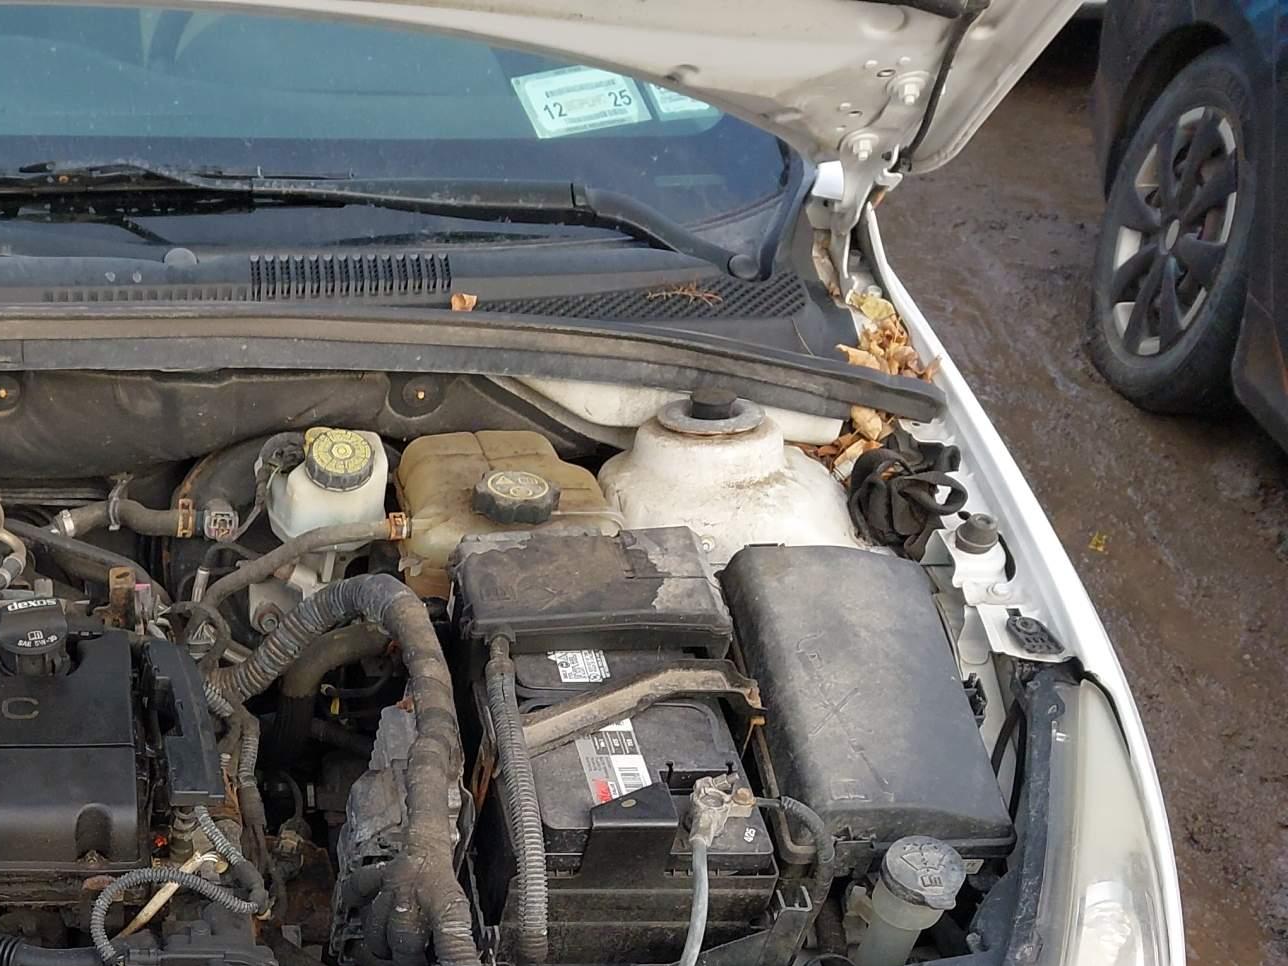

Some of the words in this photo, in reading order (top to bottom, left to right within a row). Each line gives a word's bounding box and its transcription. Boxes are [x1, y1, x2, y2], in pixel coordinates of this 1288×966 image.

[543, 102, 568, 120] 12
[608, 89, 632, 107] 25
[7, 598, 57, 612] dexos
